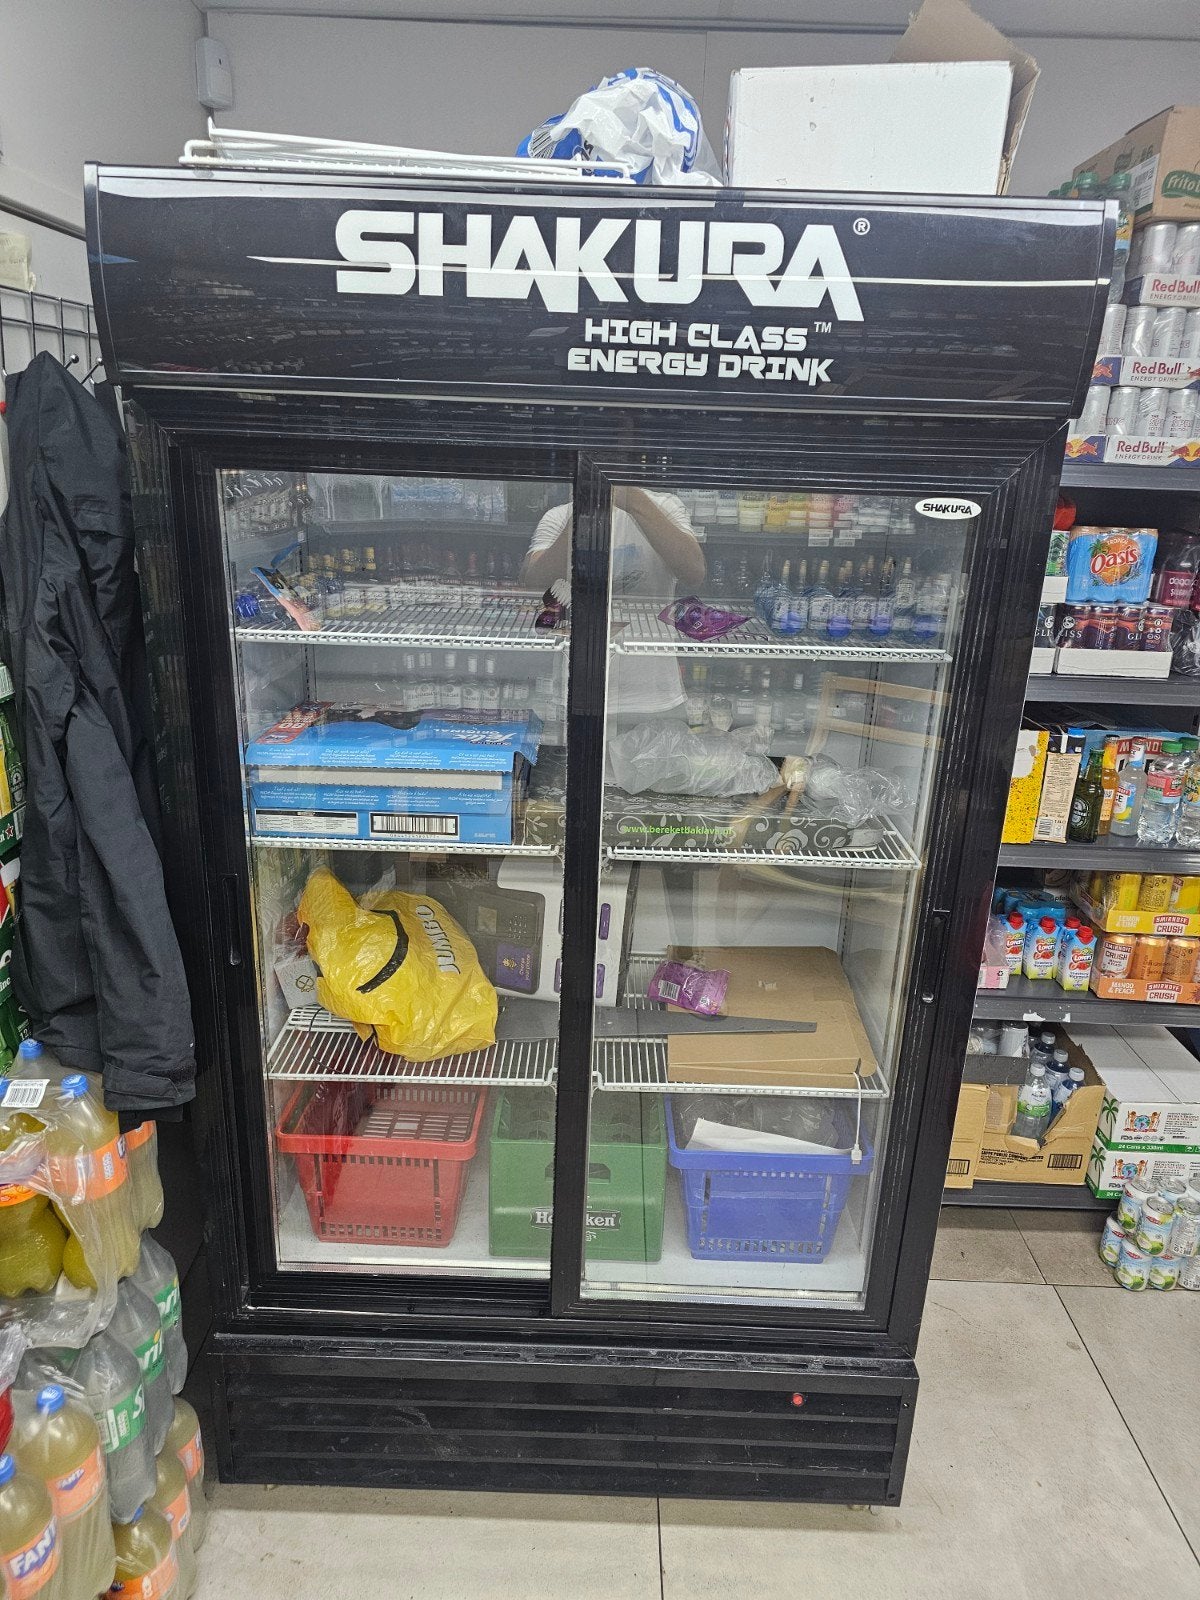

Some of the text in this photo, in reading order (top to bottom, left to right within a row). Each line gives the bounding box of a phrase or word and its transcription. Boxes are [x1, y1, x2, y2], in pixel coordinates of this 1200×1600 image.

[335, 209, 864, 321] SHAKURA
[1152, 278, 1177, 293] Red
[585, 317, 676, 346] HIGH
[687, 322, 809, 354] CLASS
[567, 347, 834, 386] ENERGY DRINK
[1132, 361, 1182, 375] Red Bull
[1116, 440, 1165, 454] Red Bull
[923, 503, 972, 515] SHAKURA
[1090, 546, 1138, 574] Oasis
[1154, 915, 1189, 926] SMIRNOFF
[1156, 925, 1184, 934] CRUSH
[415, 904, 461, 975] JUMBO
[1111, 981, 1134, 989] MANGO
[1114, 986, 1136, 995] PEACH
[1147, 983, 1182, 993] SMIRNOFF
[1149, 991, 1175, 1000] CRUSH
